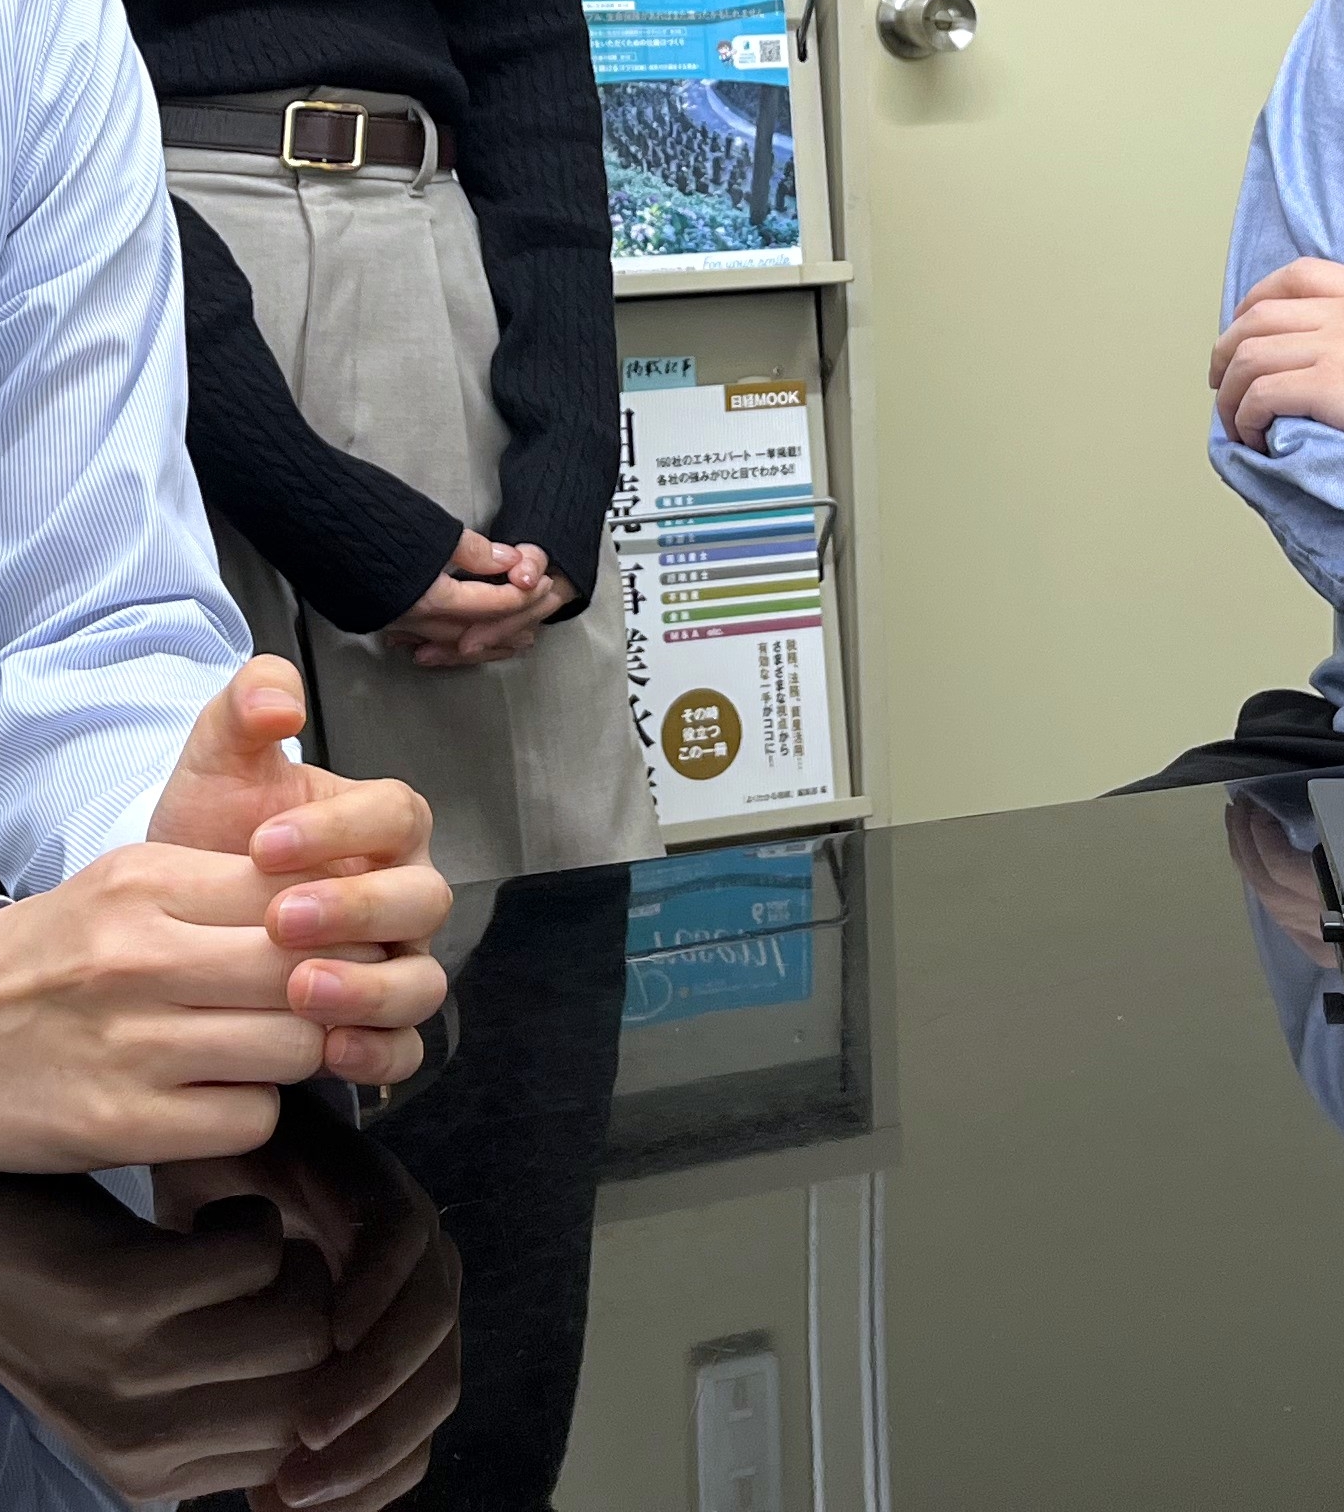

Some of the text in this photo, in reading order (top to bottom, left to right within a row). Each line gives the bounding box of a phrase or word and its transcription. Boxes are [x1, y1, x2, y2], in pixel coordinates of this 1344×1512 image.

[730, 390, 800, 409] 日経MOOK
[682, 725, 721, 742] 役立つ
[678, 741, 728, 761] この一冊
